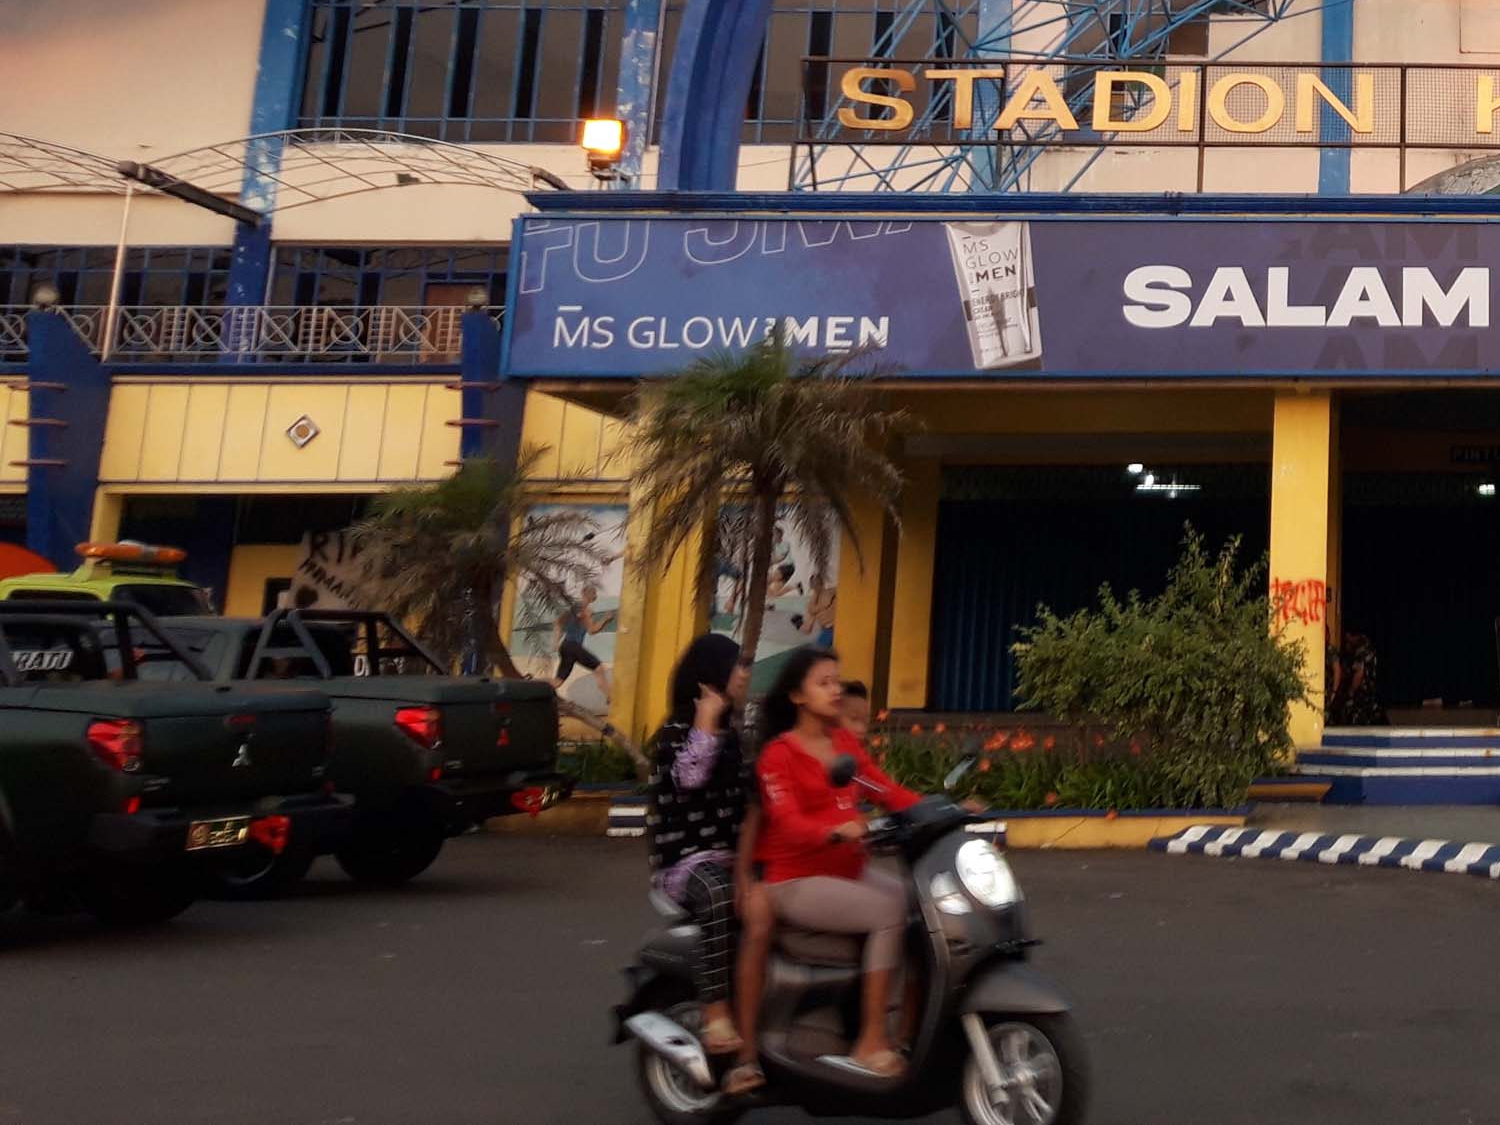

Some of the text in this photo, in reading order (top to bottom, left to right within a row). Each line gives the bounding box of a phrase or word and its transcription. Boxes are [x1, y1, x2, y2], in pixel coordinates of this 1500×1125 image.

[838, 67, 1374, 134] STADION
[965, 248, 1019, 269] GLOW
[975, 264, 1018, 283] MEN
[1122, 265, 1490, 329] SALAM
[553, 306, 615, 349] MS
[626, 315, 758, 349] GLOW
[784, 315, 890, 352] MEN
